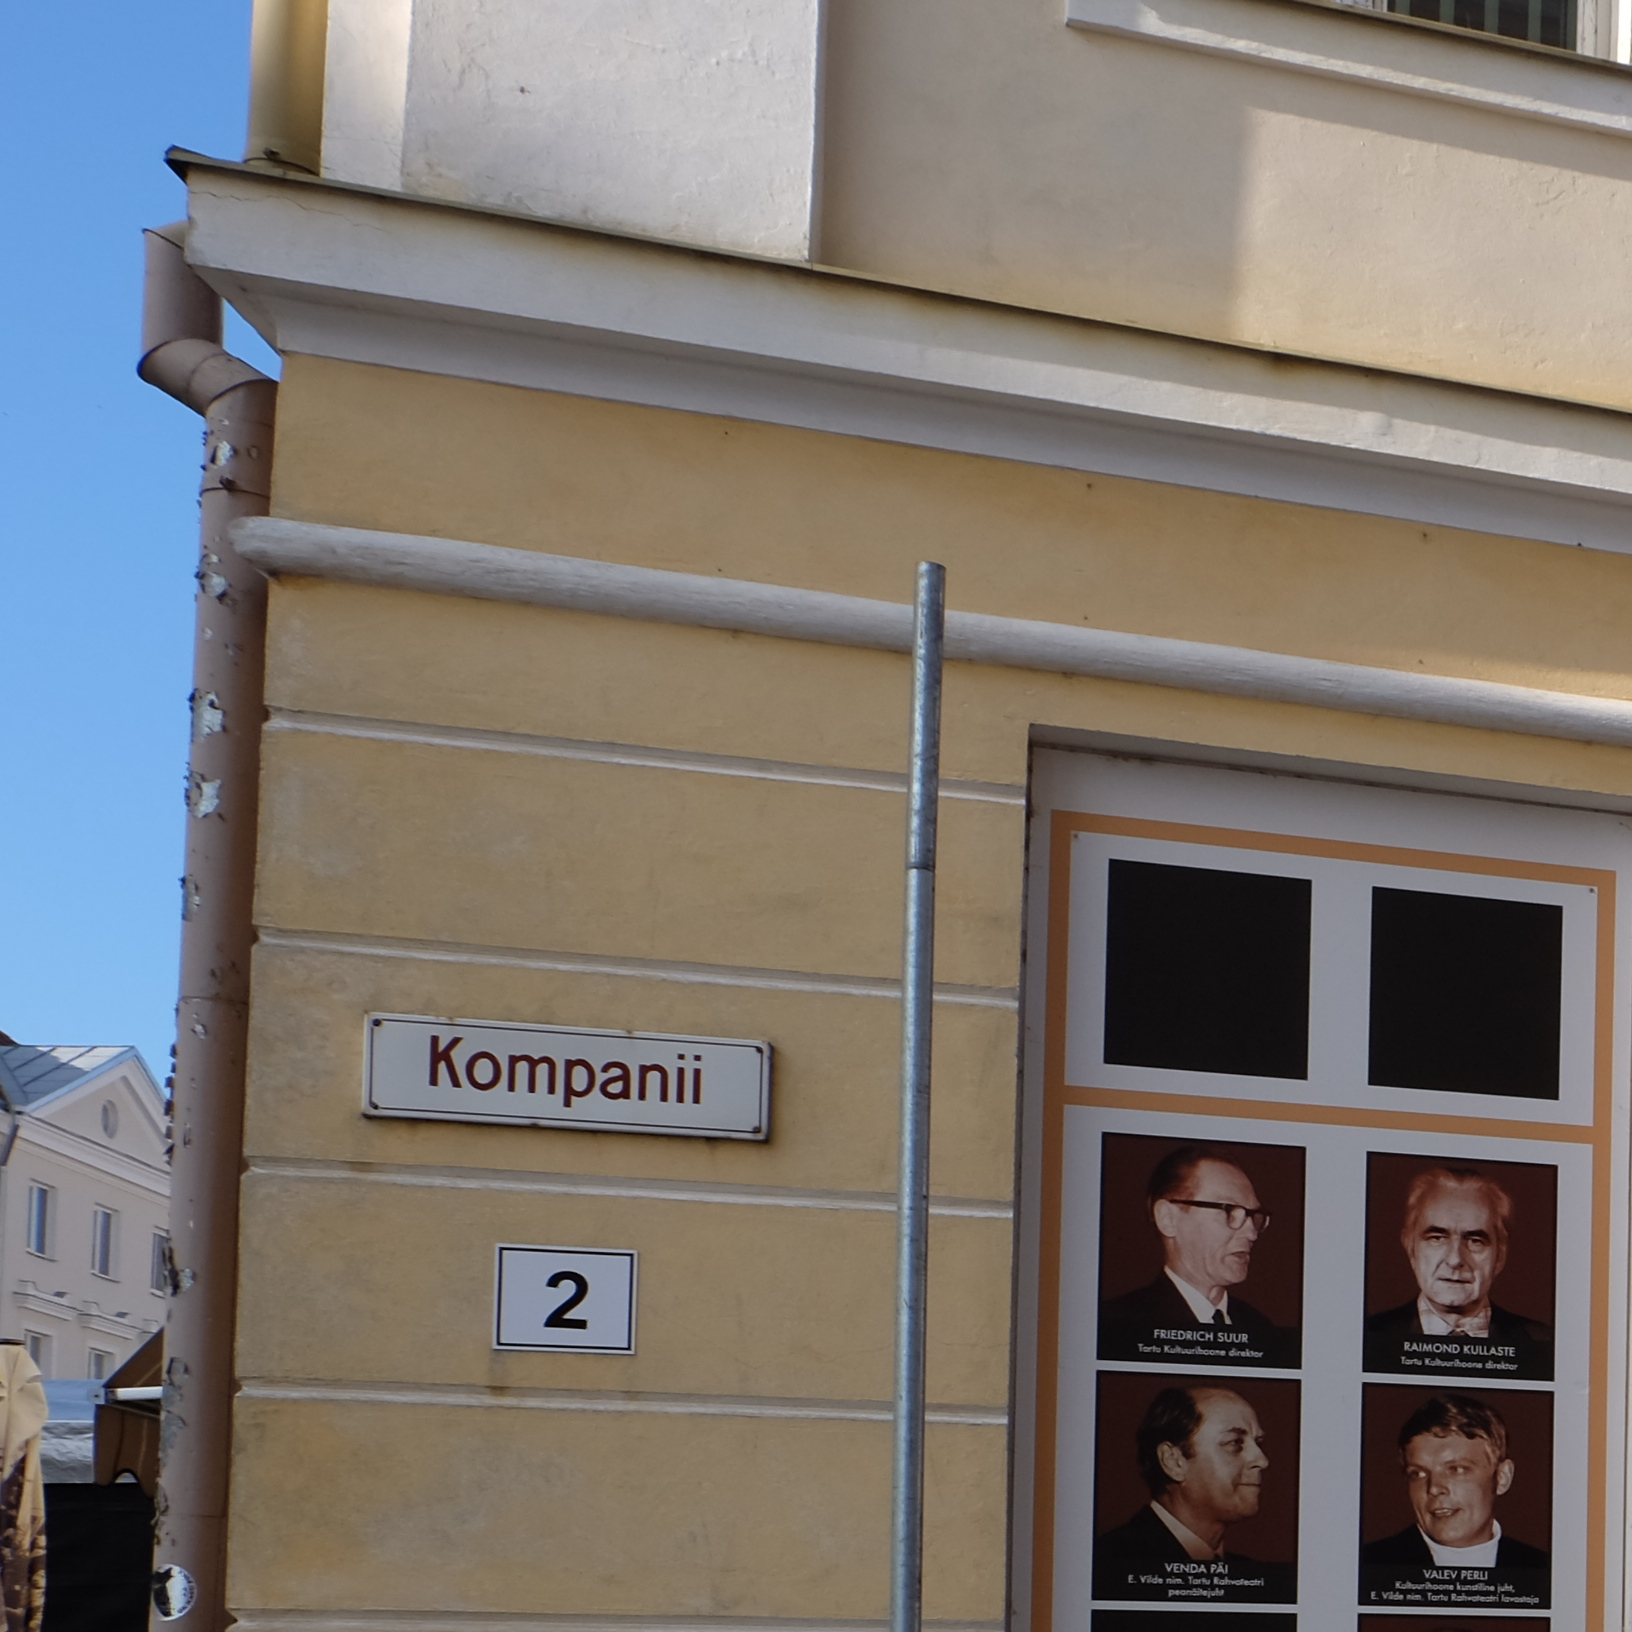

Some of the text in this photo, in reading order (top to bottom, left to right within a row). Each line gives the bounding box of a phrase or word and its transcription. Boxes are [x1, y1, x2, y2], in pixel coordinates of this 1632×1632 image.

[428, 1034, 702, 1107] Kompanii
[543, 1270, 589, 1330] 2
[1154, 1329, 1248, 1343] FRIEDRICH SUUR
[1138, 1344, 1264, 1358] Tartu Kultuurihoone direktor
[1404, 1342, 1515, 1356] RAIMOND KULLASTE
[1400, 1357, 1518, 1370] Tartu Kultuurihoone direktor
[1165, 1562, 1228, 1574] VENDA PÄI
[1128, 1575, 1137, 1583] E.
[1140, 1575, 1163, 1584] Vilde
[1188, 1576, 1210, 1585] Tartu
[1213, 1577, 1264, 1586] Rahvateatri
[1423, 1569, 1488, 1580] VALEV PERLI
[1168, 1588, 1224, 1597] peanäitejuht
[1395, 1581, 1515, 1593] Kultuurihoone kunstiline juht,
[1371, 1592, 1539, 1604] E. Vilde nim. Tartu Rahvateatri lavastaja
